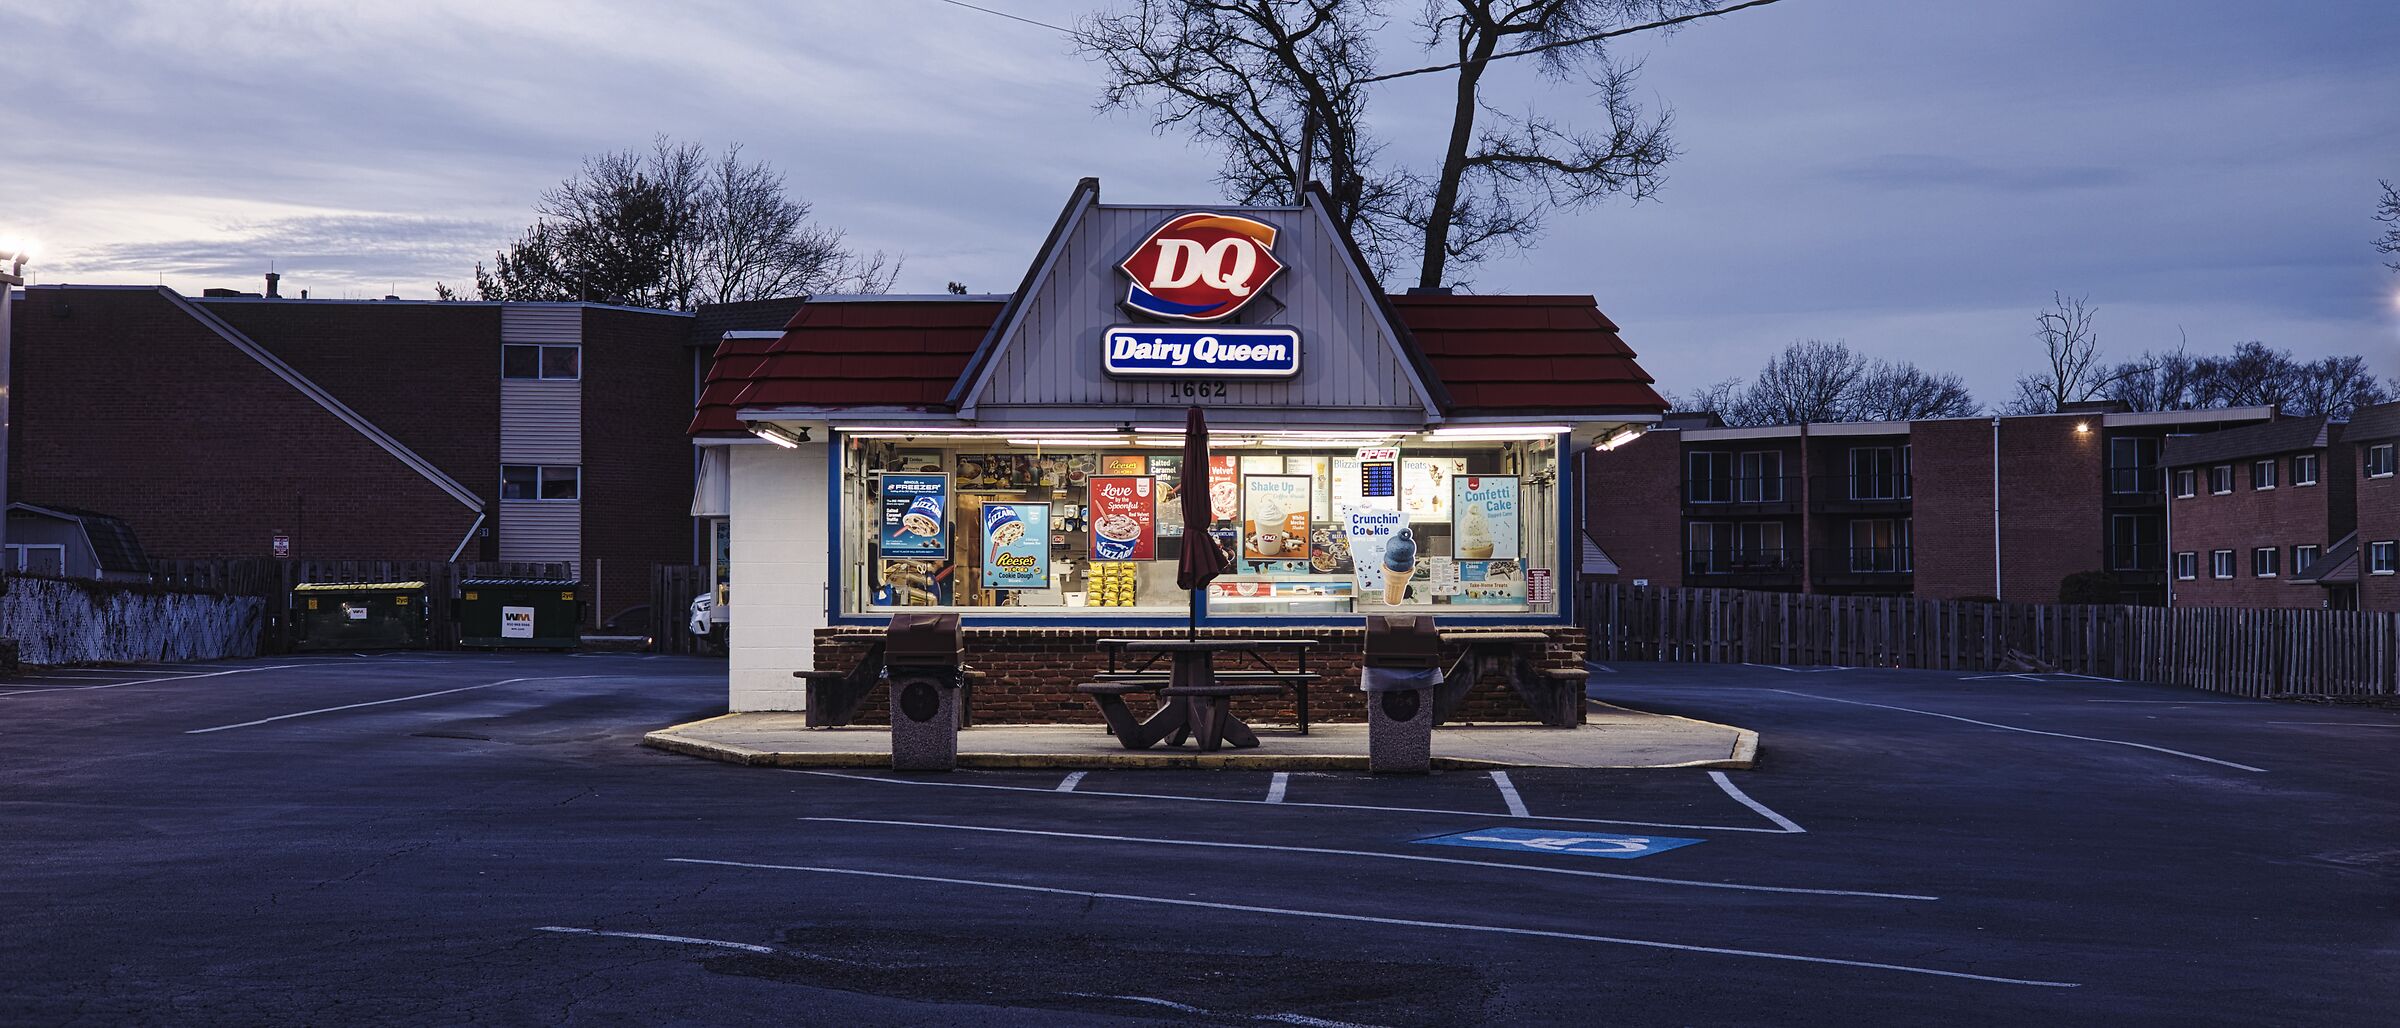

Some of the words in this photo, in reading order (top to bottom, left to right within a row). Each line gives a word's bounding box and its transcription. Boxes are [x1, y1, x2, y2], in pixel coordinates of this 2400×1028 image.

[1150, 237, 1256, 297] DQ
[1112, 336, 1191, 366] Dairy
[1193, 336, 1286, 364] Queen
[1169, 382, 1227, 398] 1662
[1360, 449, 1397, 460] OPEN
[1151, 459, 1171, 467] Salted
[1403, 461, 1427, 469] Treats
[1151, 466, 1177, 475] Caramel
[1212, 467, 1233, 475] Velvet
[1101, 483, 1132, 499] Love
[1251, 482, 1280, 491] Shake
[1282, 482, 1294, 493] Up
[1465, 488, 1510, 502] Confetti
[1108, 502, 1139, 511] Spoonful
[1486, 500, 1512, 512] Cake
[1352, 514, 1400, 524] Crunchin'
[996, 553, 1035, 567] Reese's
[506, 613, 530, 621] WM
